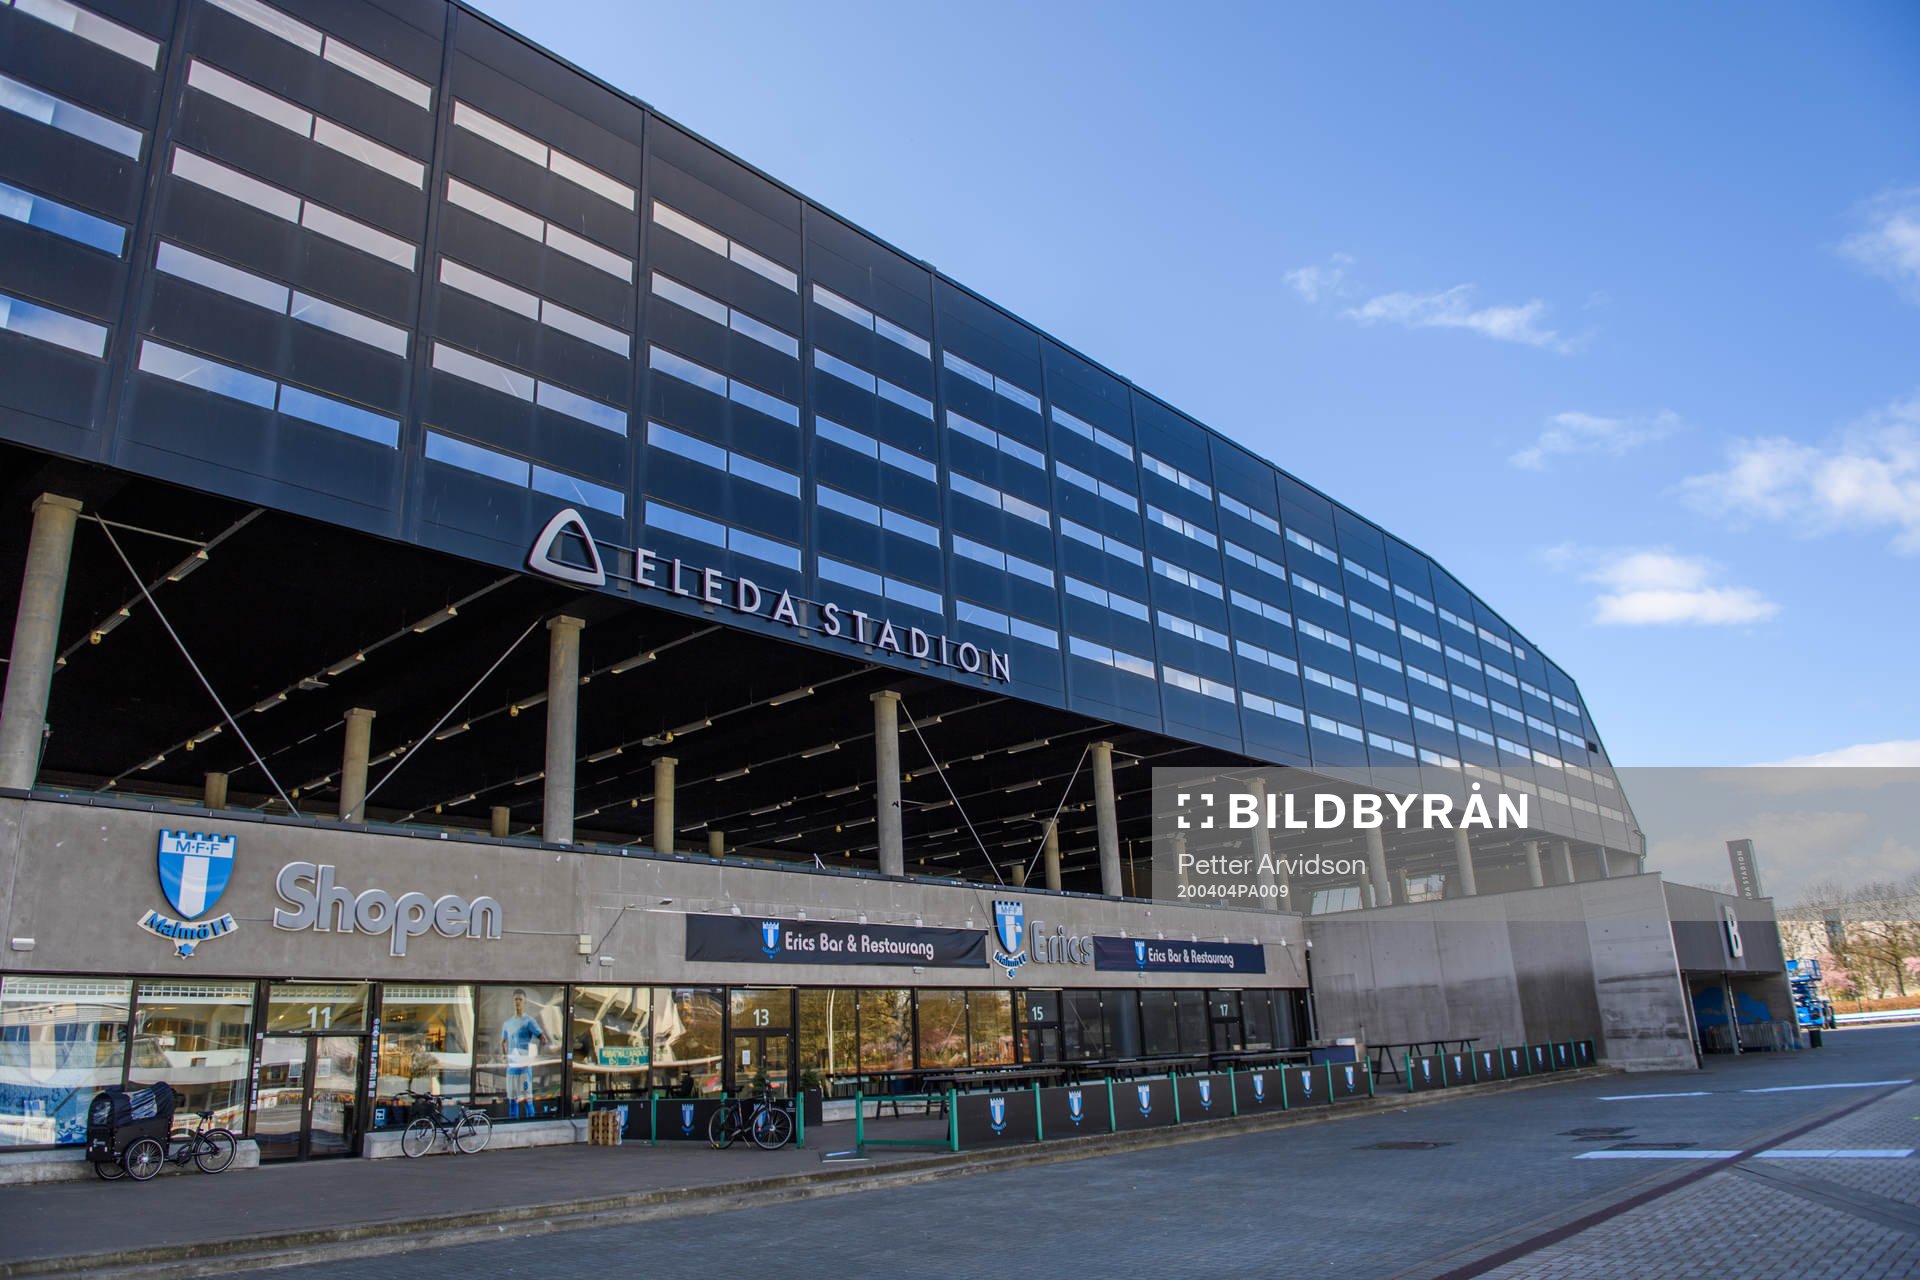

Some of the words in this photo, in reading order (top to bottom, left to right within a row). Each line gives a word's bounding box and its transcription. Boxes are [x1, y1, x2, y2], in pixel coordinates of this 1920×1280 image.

[635, 547, 799, 626] ELEDA
[823, 602, 1011, 684] STADION
[273, 861, 502, 957] Shopen
[144, 912, 210, 940] Malmö
[210, 914, 232, 936] FF
[1724, 905, 1743, 958] B
[785, 931, 815, 951] Erics
[820, 932, 844, 952] Bar
[847, 934, 857, 953] &
[861, 934, 934, 961] Restaurang
[1029, 920, 1094, 965] Erics
[1148, 947, 1166, 962] Erics
[1167, 948, 1181, 963] Bar
[1183, 949, 1190, 963] &
[1191, 949, 1234, 969] Restaurang
[307, 1006, 332, 1029] 11
[753, 1008, 769, 1027] 13
[1031, 1006, 1044, 1021] 15
[1220, 1004, 1228, 1017] 17
